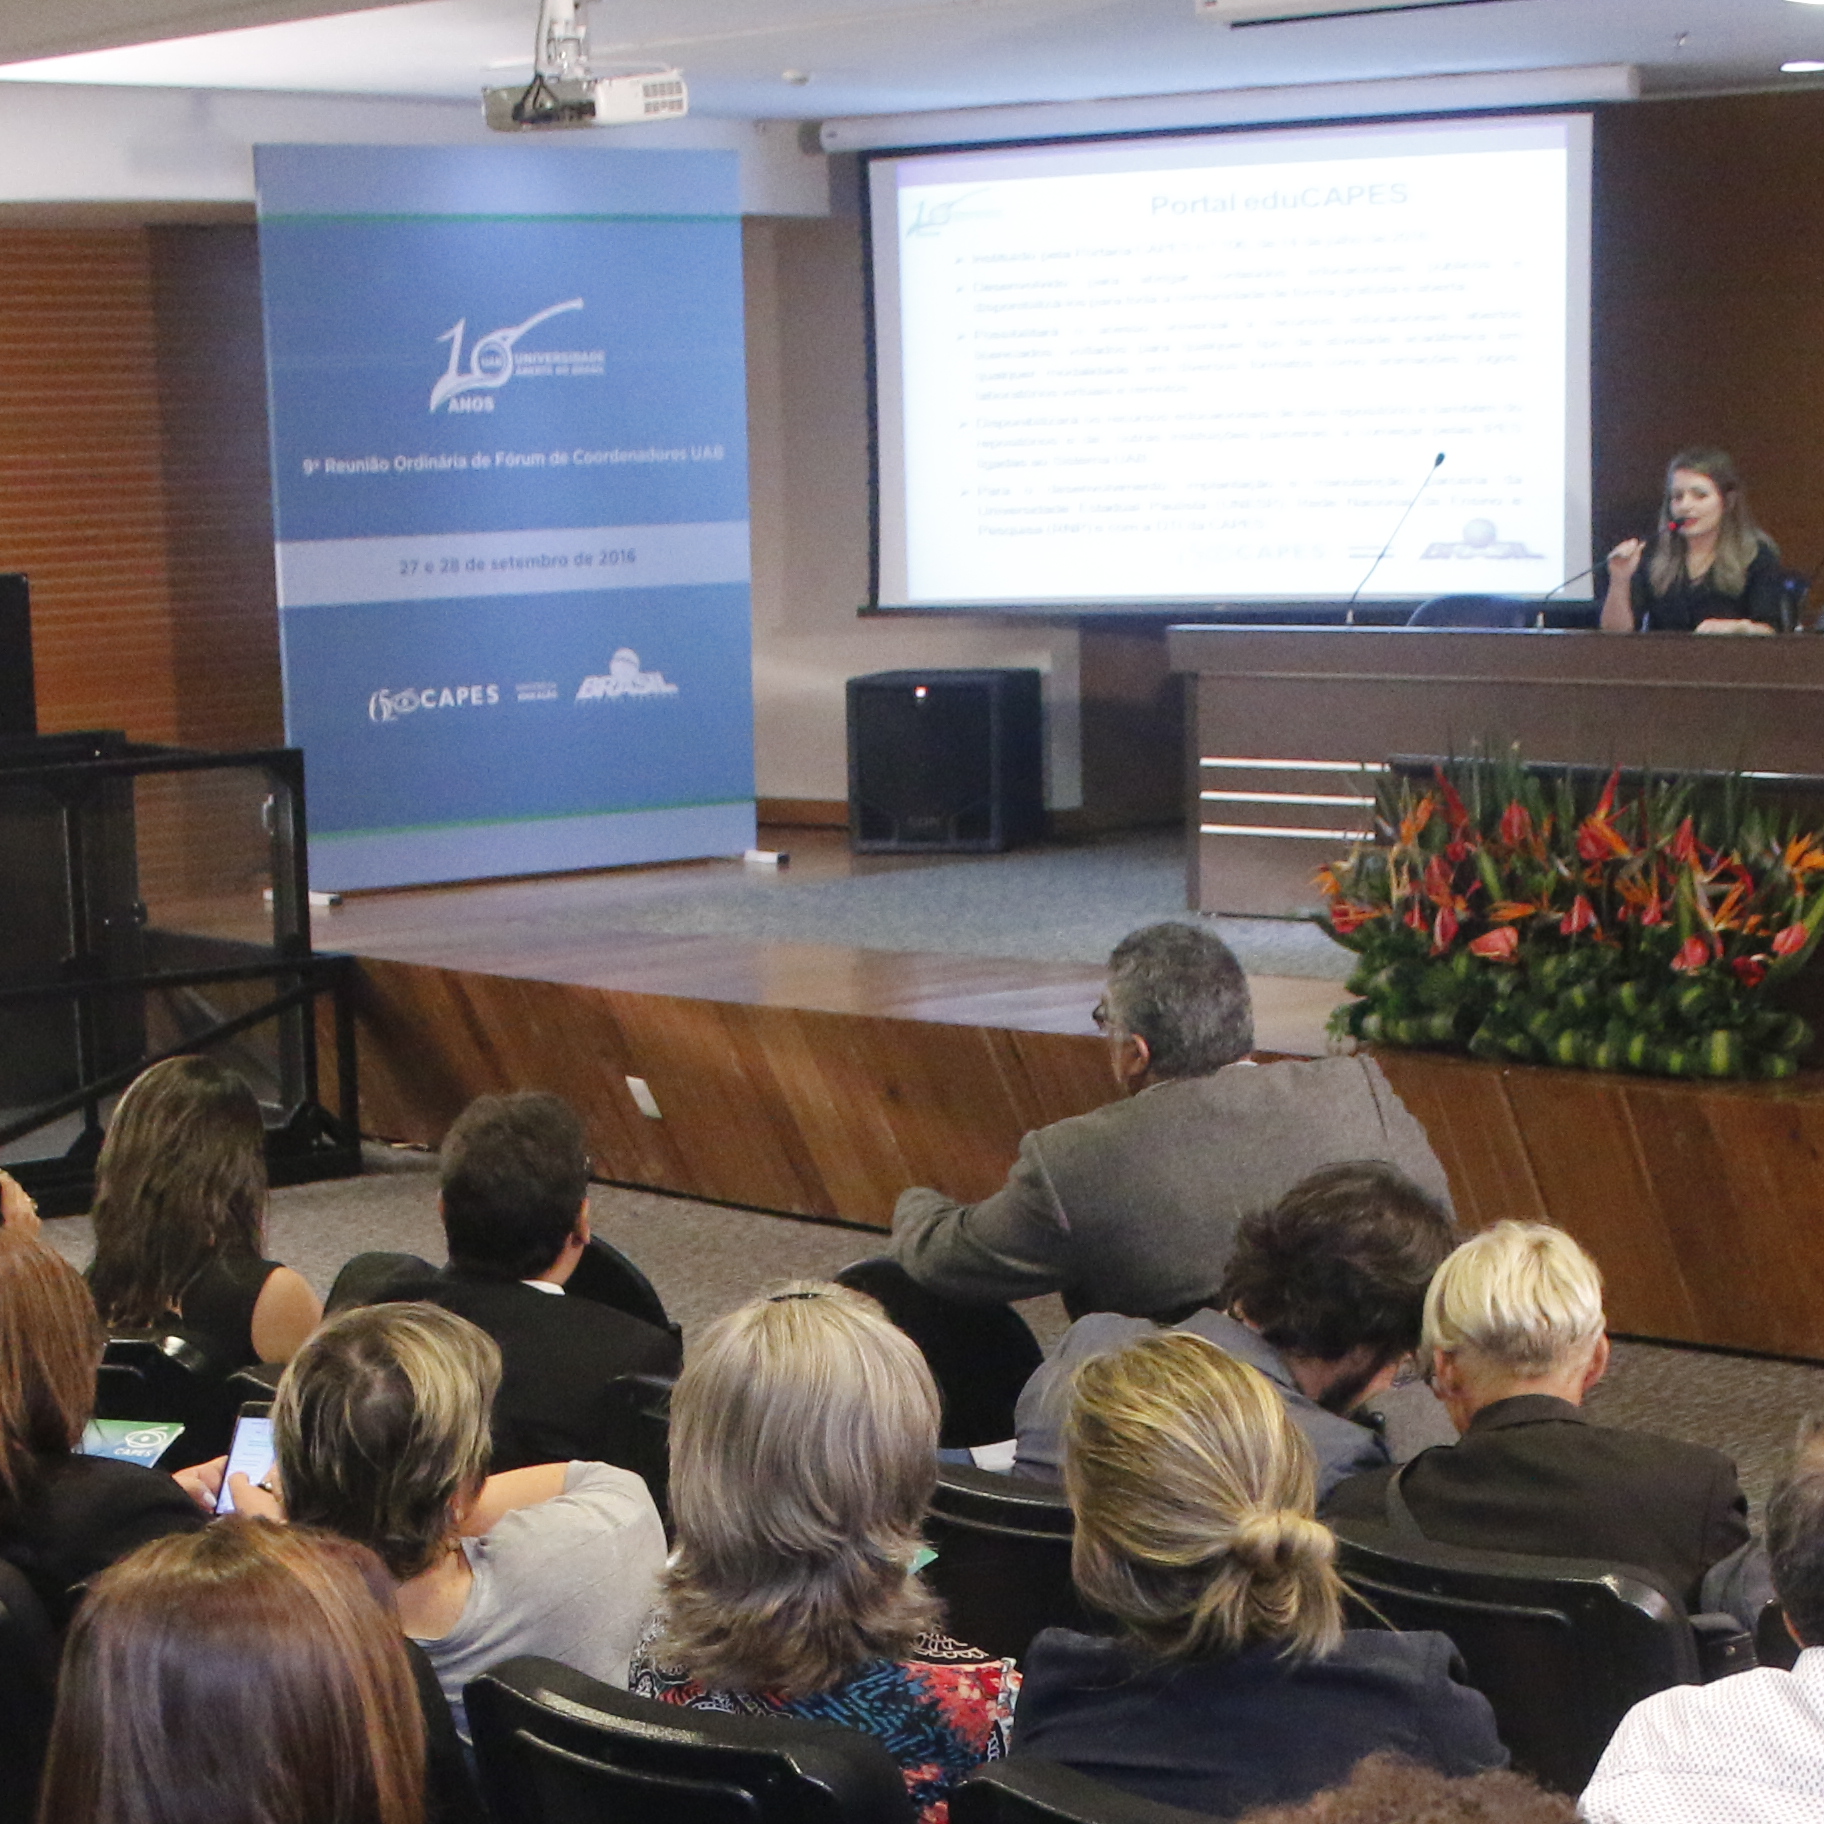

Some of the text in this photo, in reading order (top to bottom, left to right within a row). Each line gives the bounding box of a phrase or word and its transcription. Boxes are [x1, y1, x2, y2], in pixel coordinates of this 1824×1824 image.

[1149, 180, 1409, 217] Portal eduCAPES
[448, 397, 495, 413] ANOS
[324, 455, 390, 473] Reunião
[393, 453, 467, 471] Ordinária
[470, 452, 491, 468] de
[494, 451, 545, 466] Fórum
[549, 451, 568, 465] de
[572, 448, 687, 464] Coordenadores
[690, 446, 725, 461] UAB
[399, 548, 636, 575] 27 e 28 de setembro de 2016
[420, 684, 500, 708] CAPES
[114, 1447, 152, 1458] CAPES
